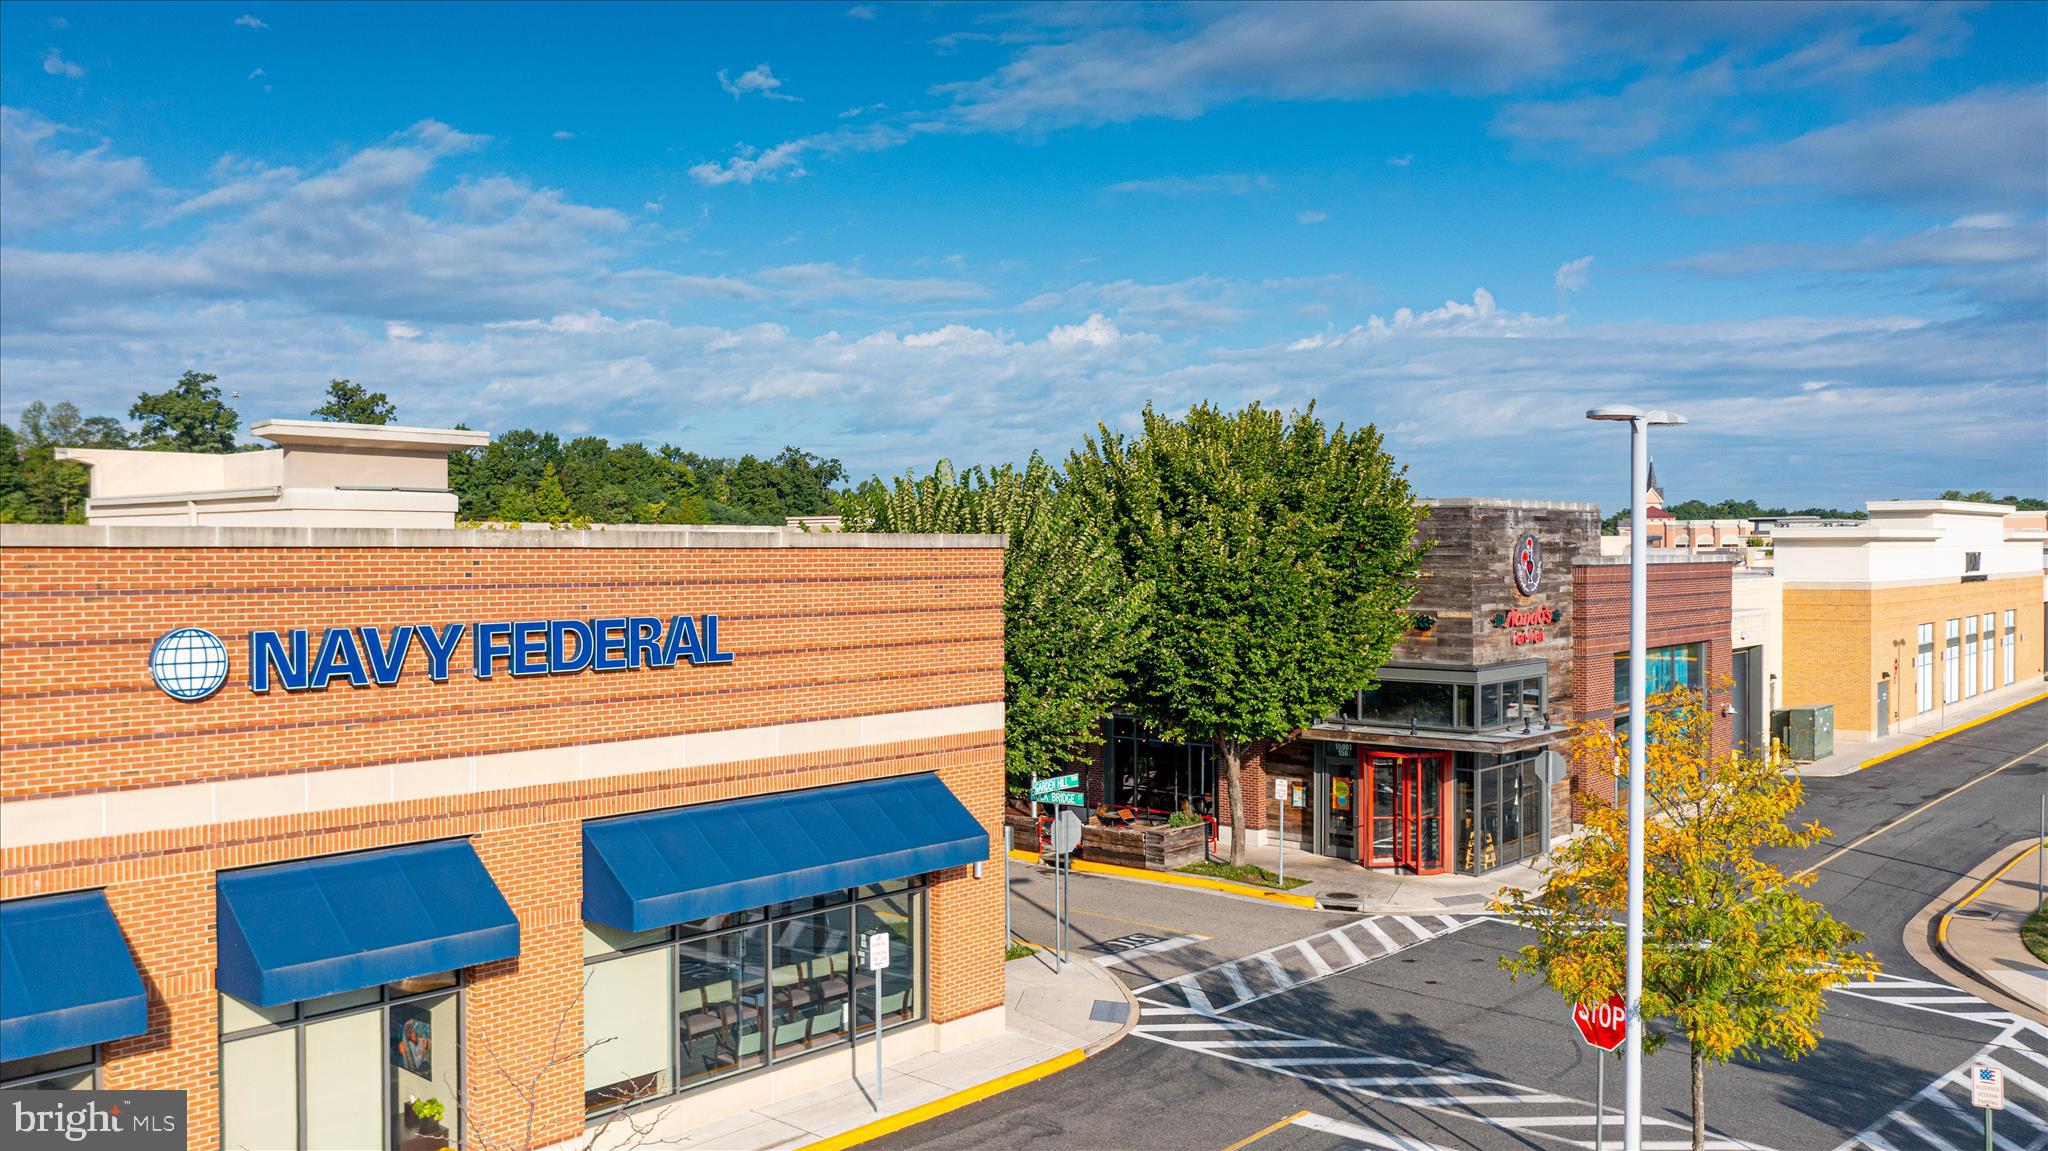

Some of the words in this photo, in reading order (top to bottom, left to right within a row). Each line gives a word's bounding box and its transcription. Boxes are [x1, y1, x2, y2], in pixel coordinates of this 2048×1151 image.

[1503, 604, 1553, 628] Nando's
[249, 623, 465, 693] NAVY
[473, 614, 735, 681] FEDERAL
[1034, 779, 1056, 792] GARDEN
[1058, 778, 1069, 788] HILL
[1051, 792, 1075, 805] BRIDGE
[1578, 1000, 1625, 1031] STOP
